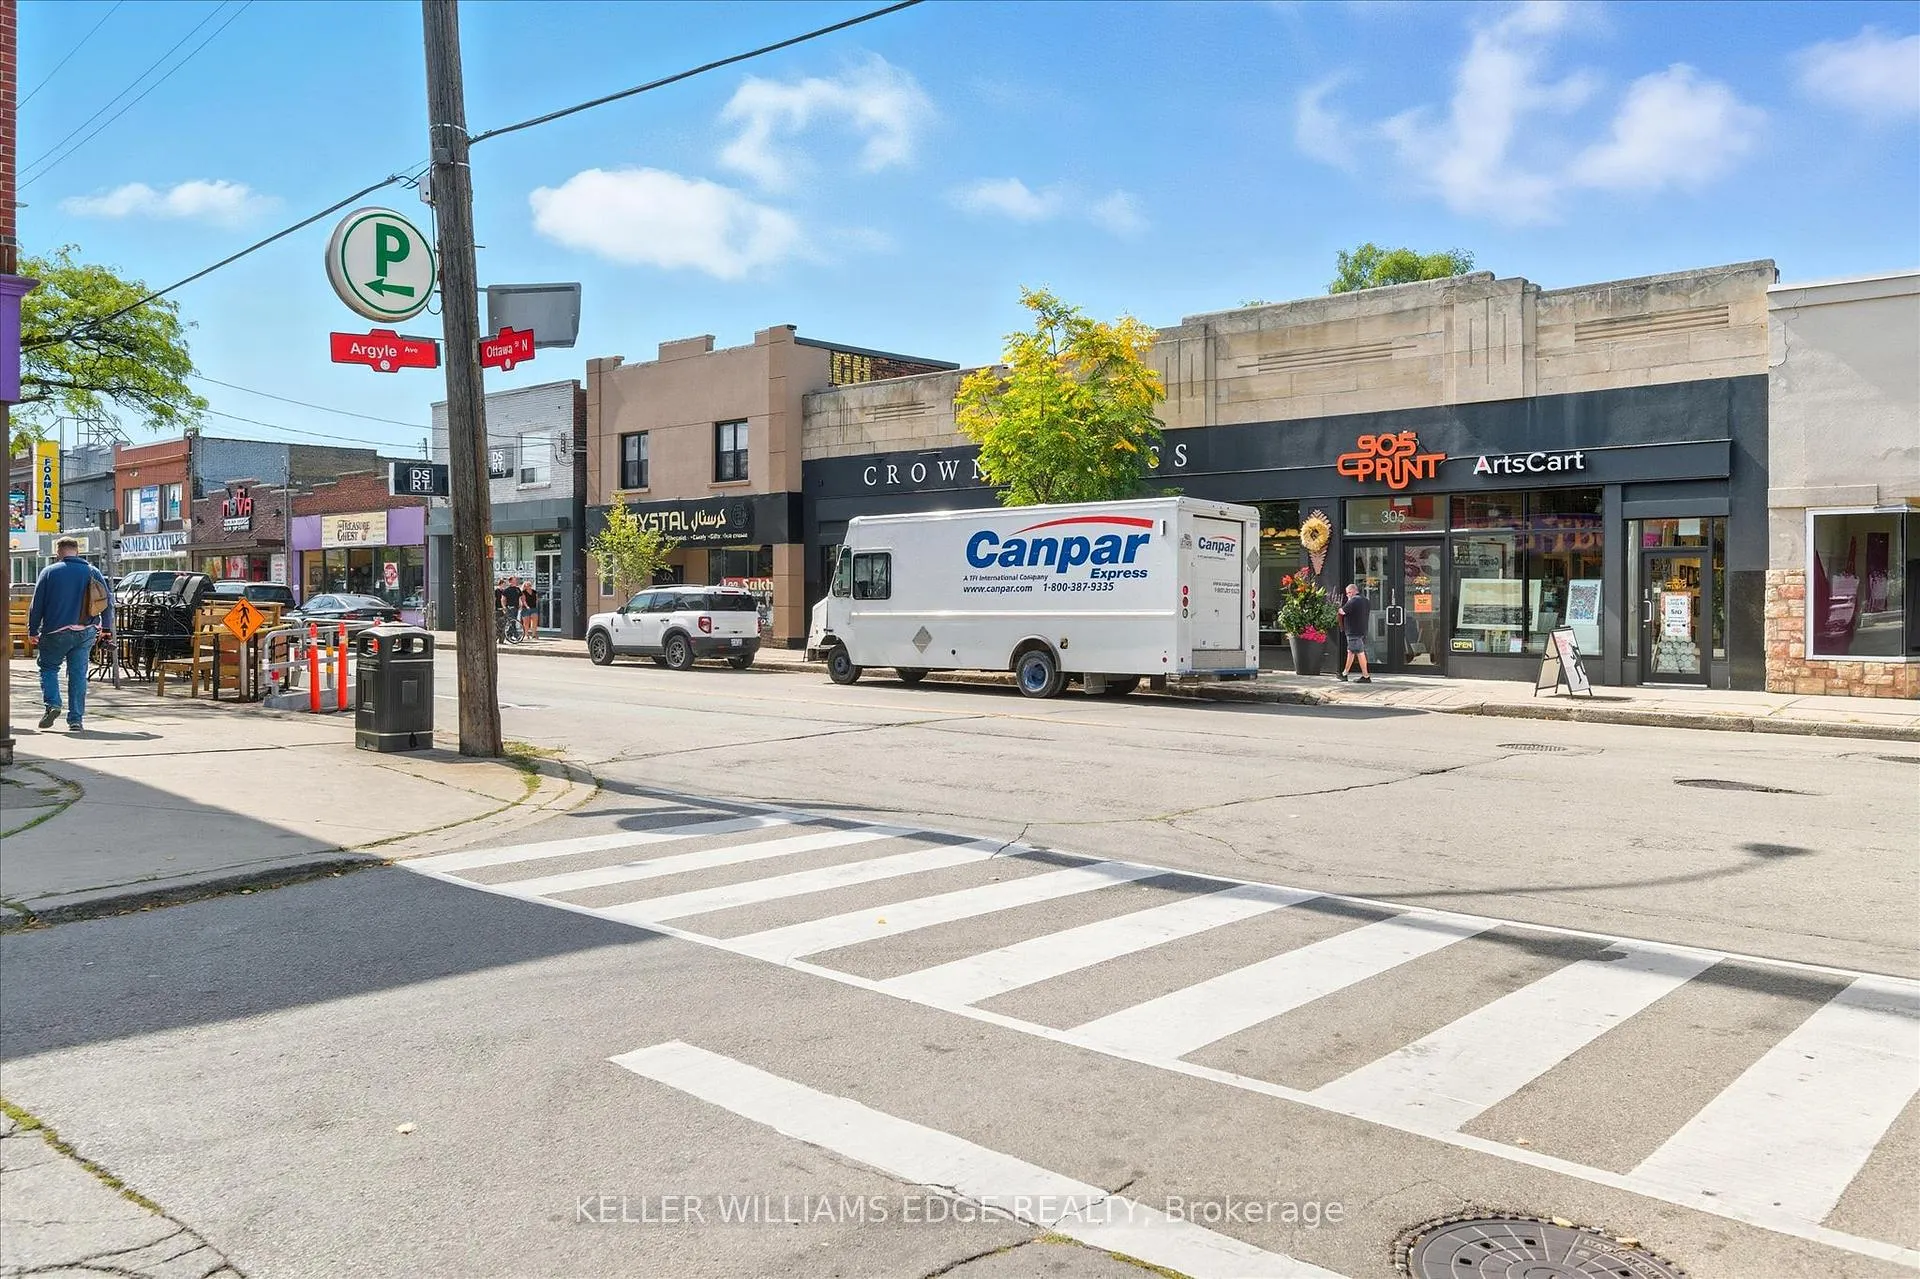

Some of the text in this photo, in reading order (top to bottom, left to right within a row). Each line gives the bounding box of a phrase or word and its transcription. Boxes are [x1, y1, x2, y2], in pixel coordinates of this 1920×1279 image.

[376, 223, 410, 277] P
[350, 342, 397, 359] Argyle
[487, 345, 512, 358] Ottawa
[522, 339, 528, 351] N
[1336, 452, 1447, 489] PRINT
[1473, 451, 1584, 475] ArtsCart
[1381, 510, 1405, 523] 305
[966, 530, 1151, 574] Canpar
[1198, 537, 1236, 553] Canpar
[1020, 574, 1048, 582] Company
[1090, 568, 1148, 581] Express
[963, 582, 1114, 594] www.canpar.com 1-800-387-9335
